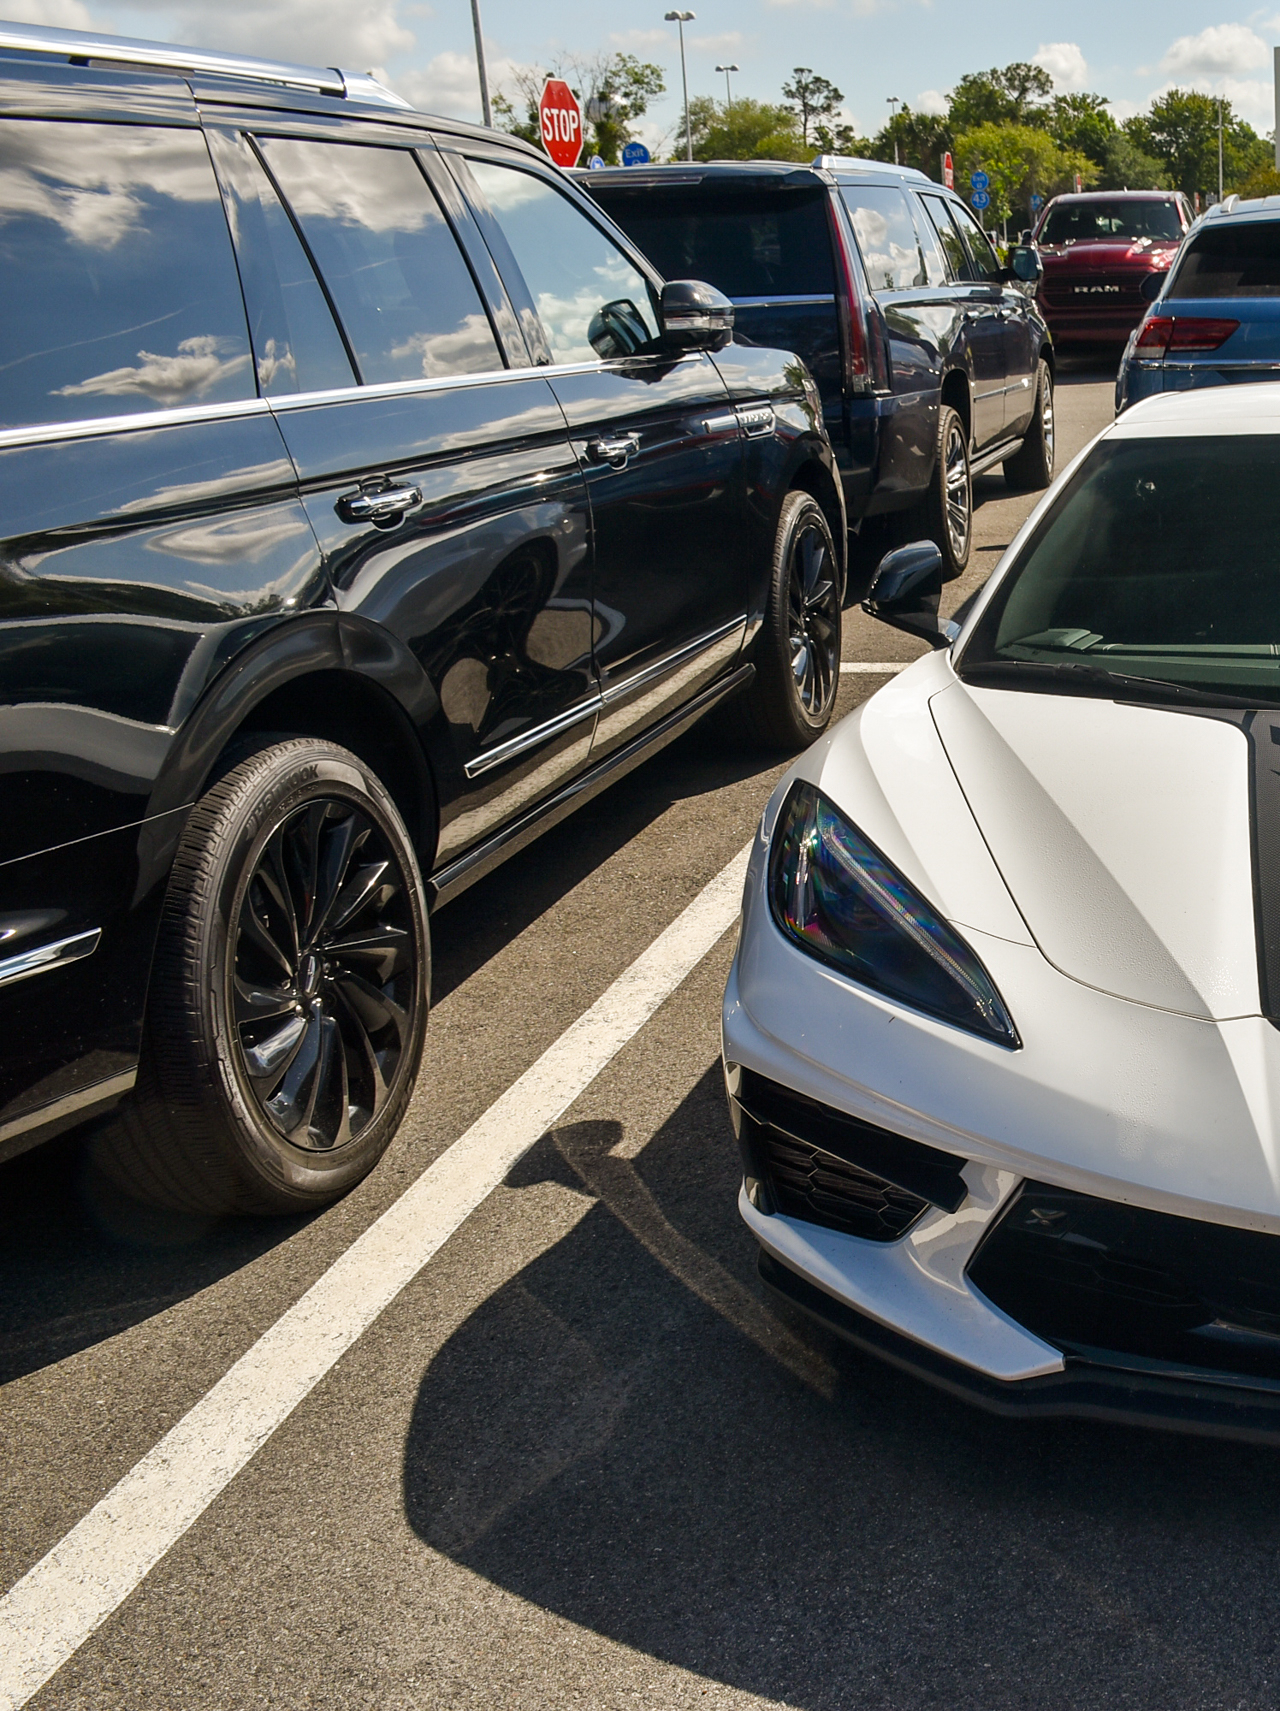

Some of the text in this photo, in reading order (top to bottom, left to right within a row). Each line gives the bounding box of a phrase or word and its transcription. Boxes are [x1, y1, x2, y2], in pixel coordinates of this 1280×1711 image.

[542, 107, 579, 143] STOP
[625, 147, 645, 159] Exit
[973, 193, 987, 203] 43
[1073, 285, 1120, 294] RAM
